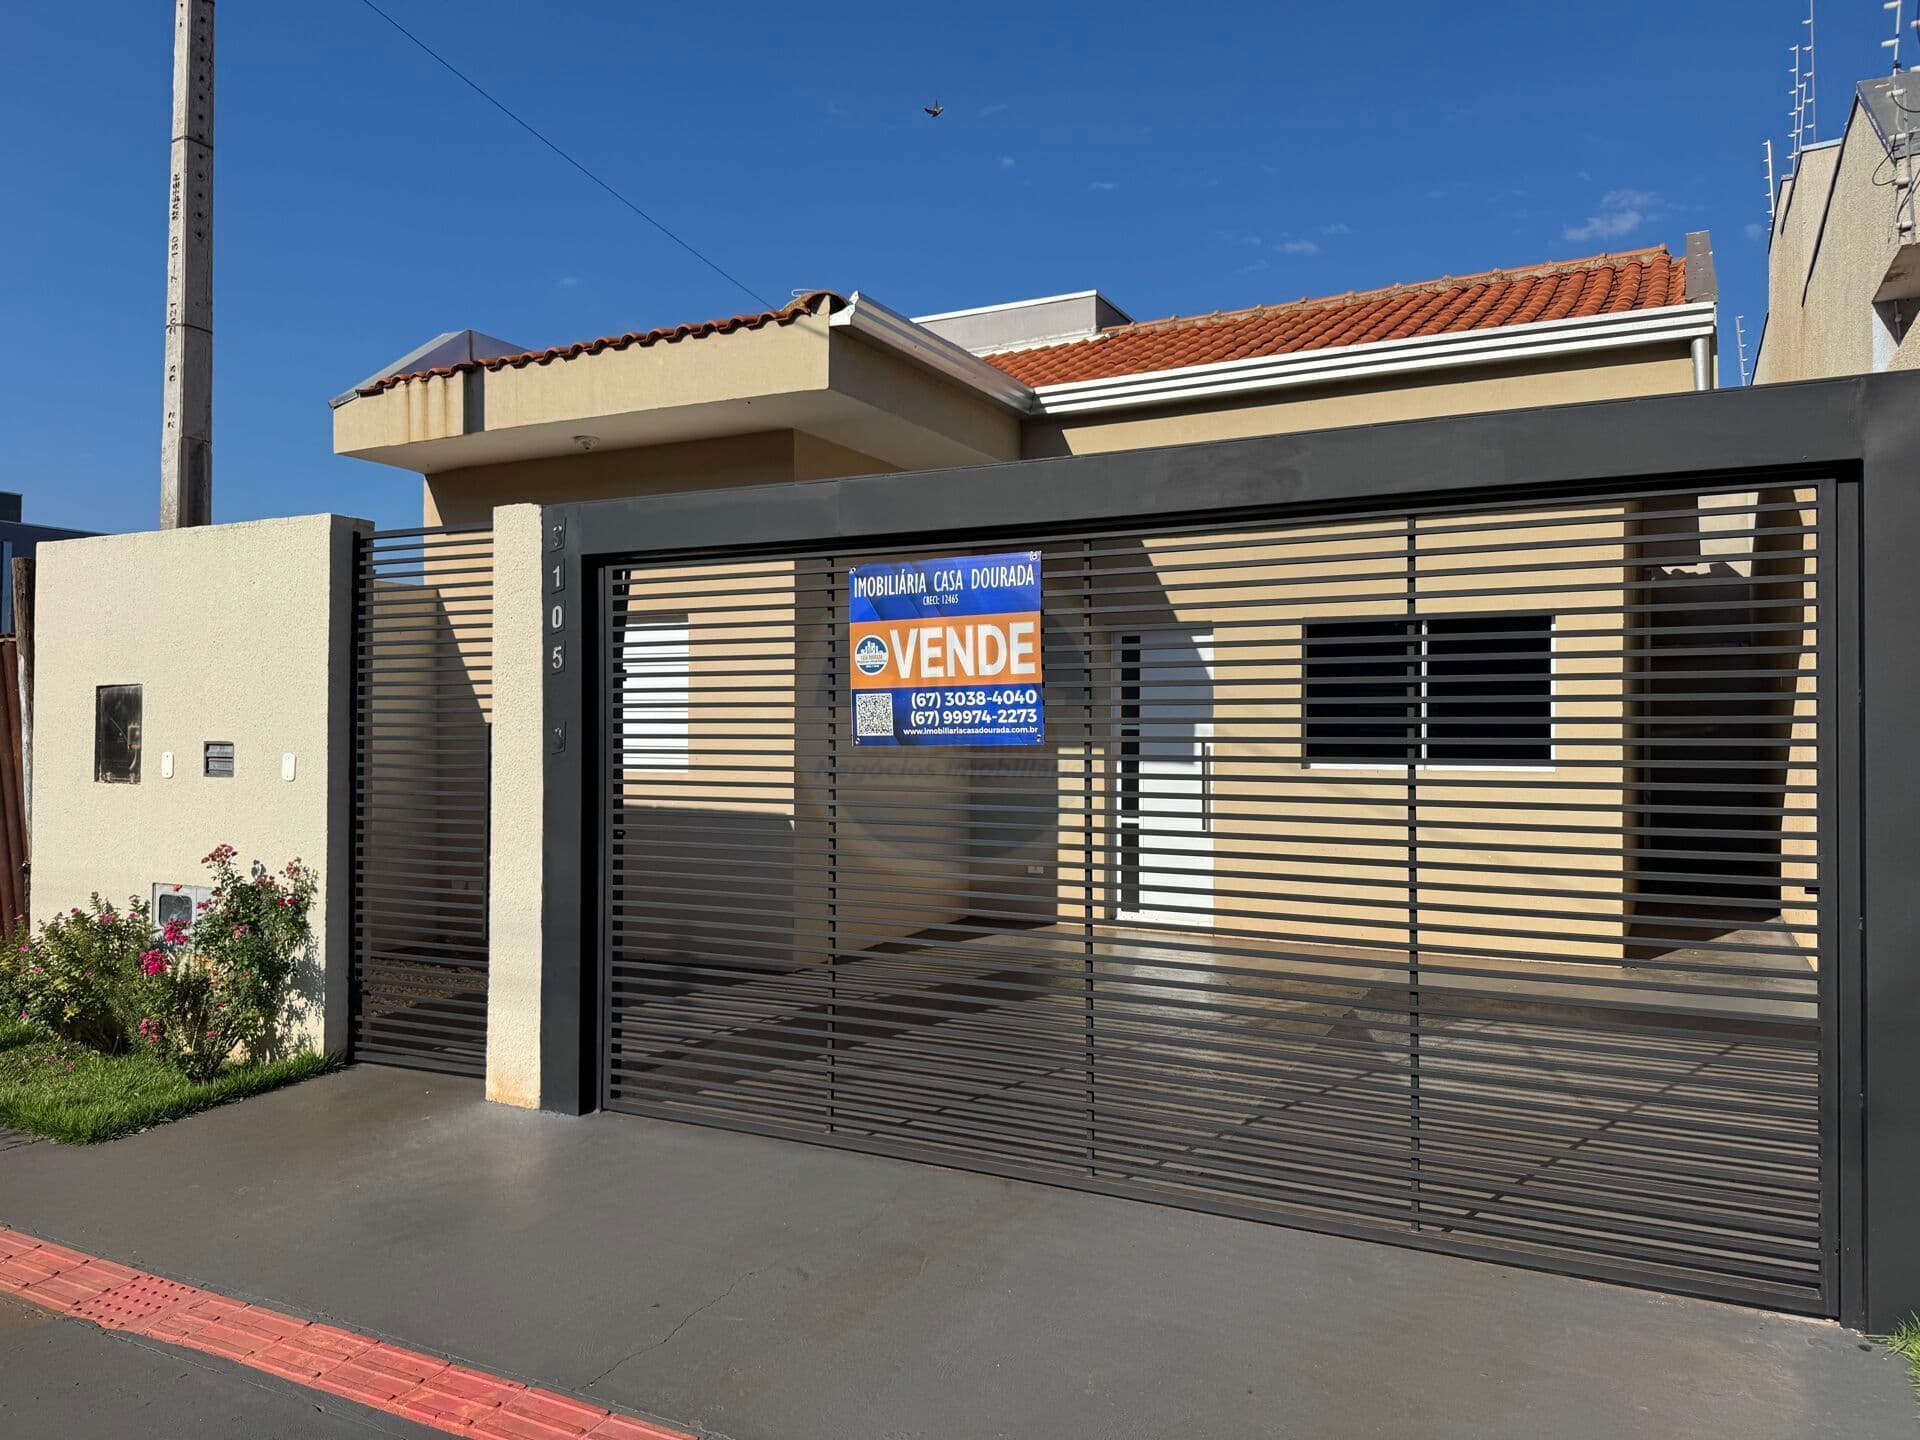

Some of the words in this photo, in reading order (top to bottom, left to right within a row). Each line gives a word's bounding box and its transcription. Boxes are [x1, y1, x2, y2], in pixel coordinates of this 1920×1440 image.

[854, 569, 926, 598] IMOBILIÁRIA
[933, 570, 964, 592] CASA
[971, 564, 1035, 589] DOURADA
[890, 622, 1036, 679] VENDE
[911, 693, 941, 709] (67)
[944, 689, 1037, 706] 3038-4040
[910, 711, 940, 727] (67)
[942, 709, 1037, 724] 99974-2273
[903, 725, 1039, 736] www.imobiliariacasadourada.com.br
